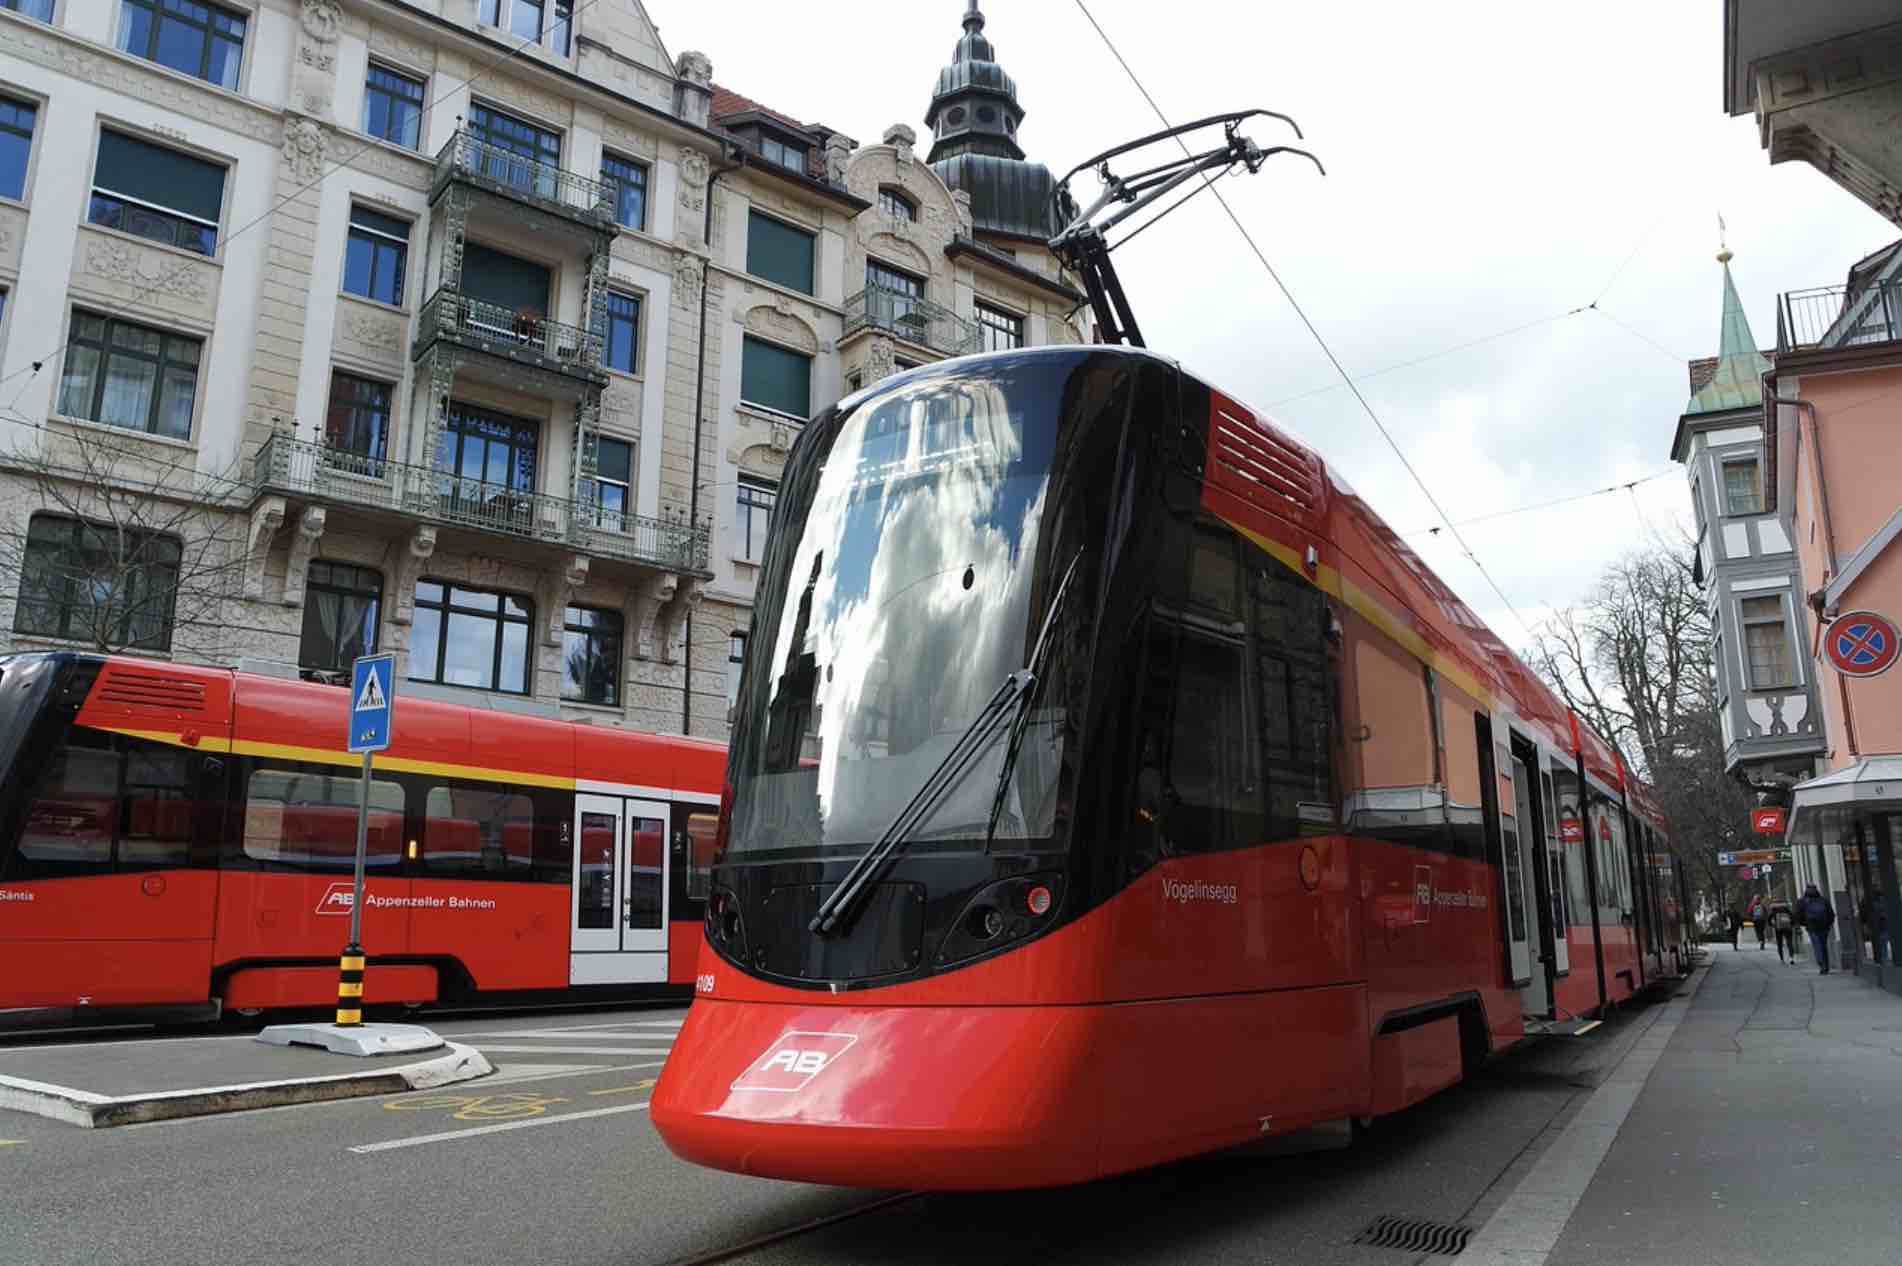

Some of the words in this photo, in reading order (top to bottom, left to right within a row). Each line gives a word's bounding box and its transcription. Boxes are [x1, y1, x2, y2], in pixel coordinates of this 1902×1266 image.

[366, 894, 445, 909] Appenzeller
[449, 896, 496, 910] Bahnen
[1161, 877, 1239, 904] Vögelinsegg
[759, 1049, 828, 1073] AB
